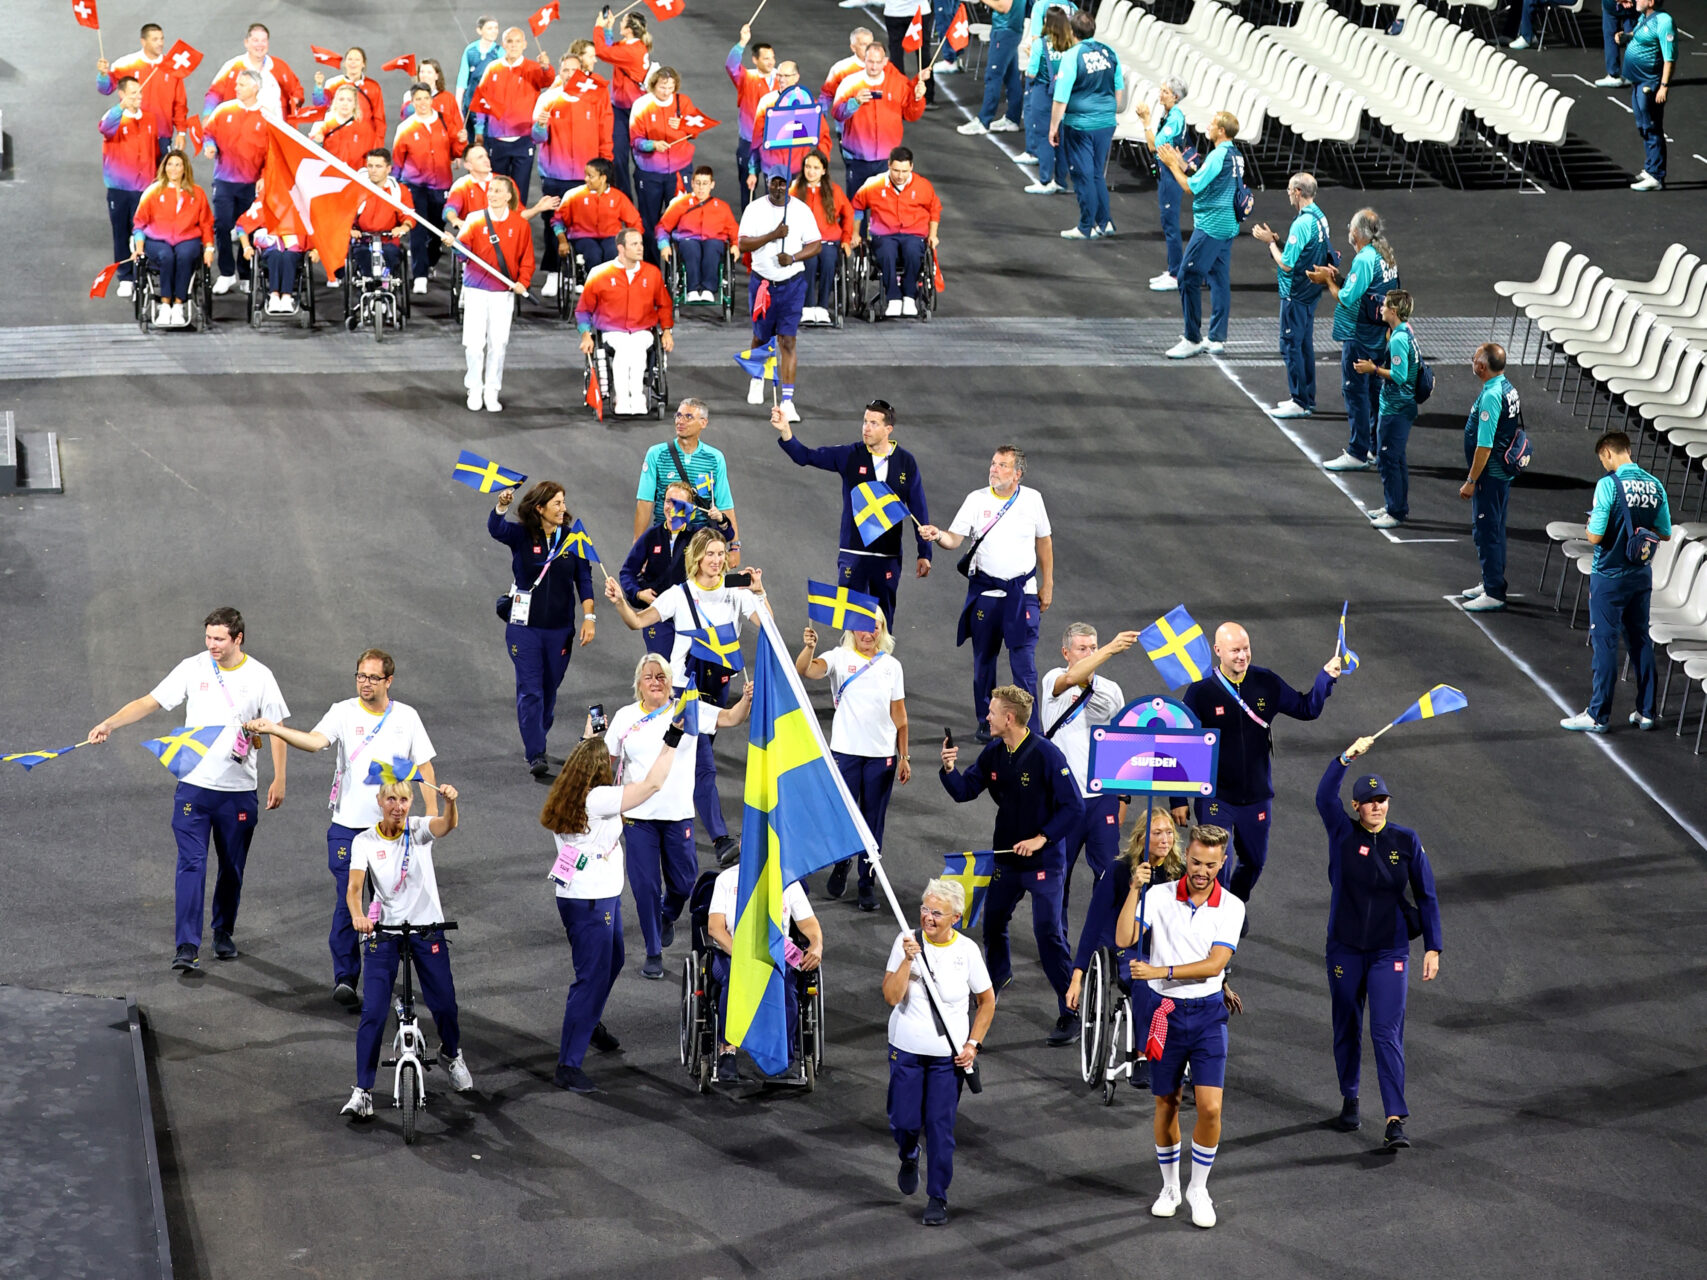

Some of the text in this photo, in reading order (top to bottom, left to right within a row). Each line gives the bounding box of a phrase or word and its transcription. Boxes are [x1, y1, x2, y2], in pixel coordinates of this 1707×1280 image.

[1622, 480, 1657, 494] PARIS
[1626, 494, 1658, 508] 2024
[1130, 756, 1177, 768] SWEDEN
